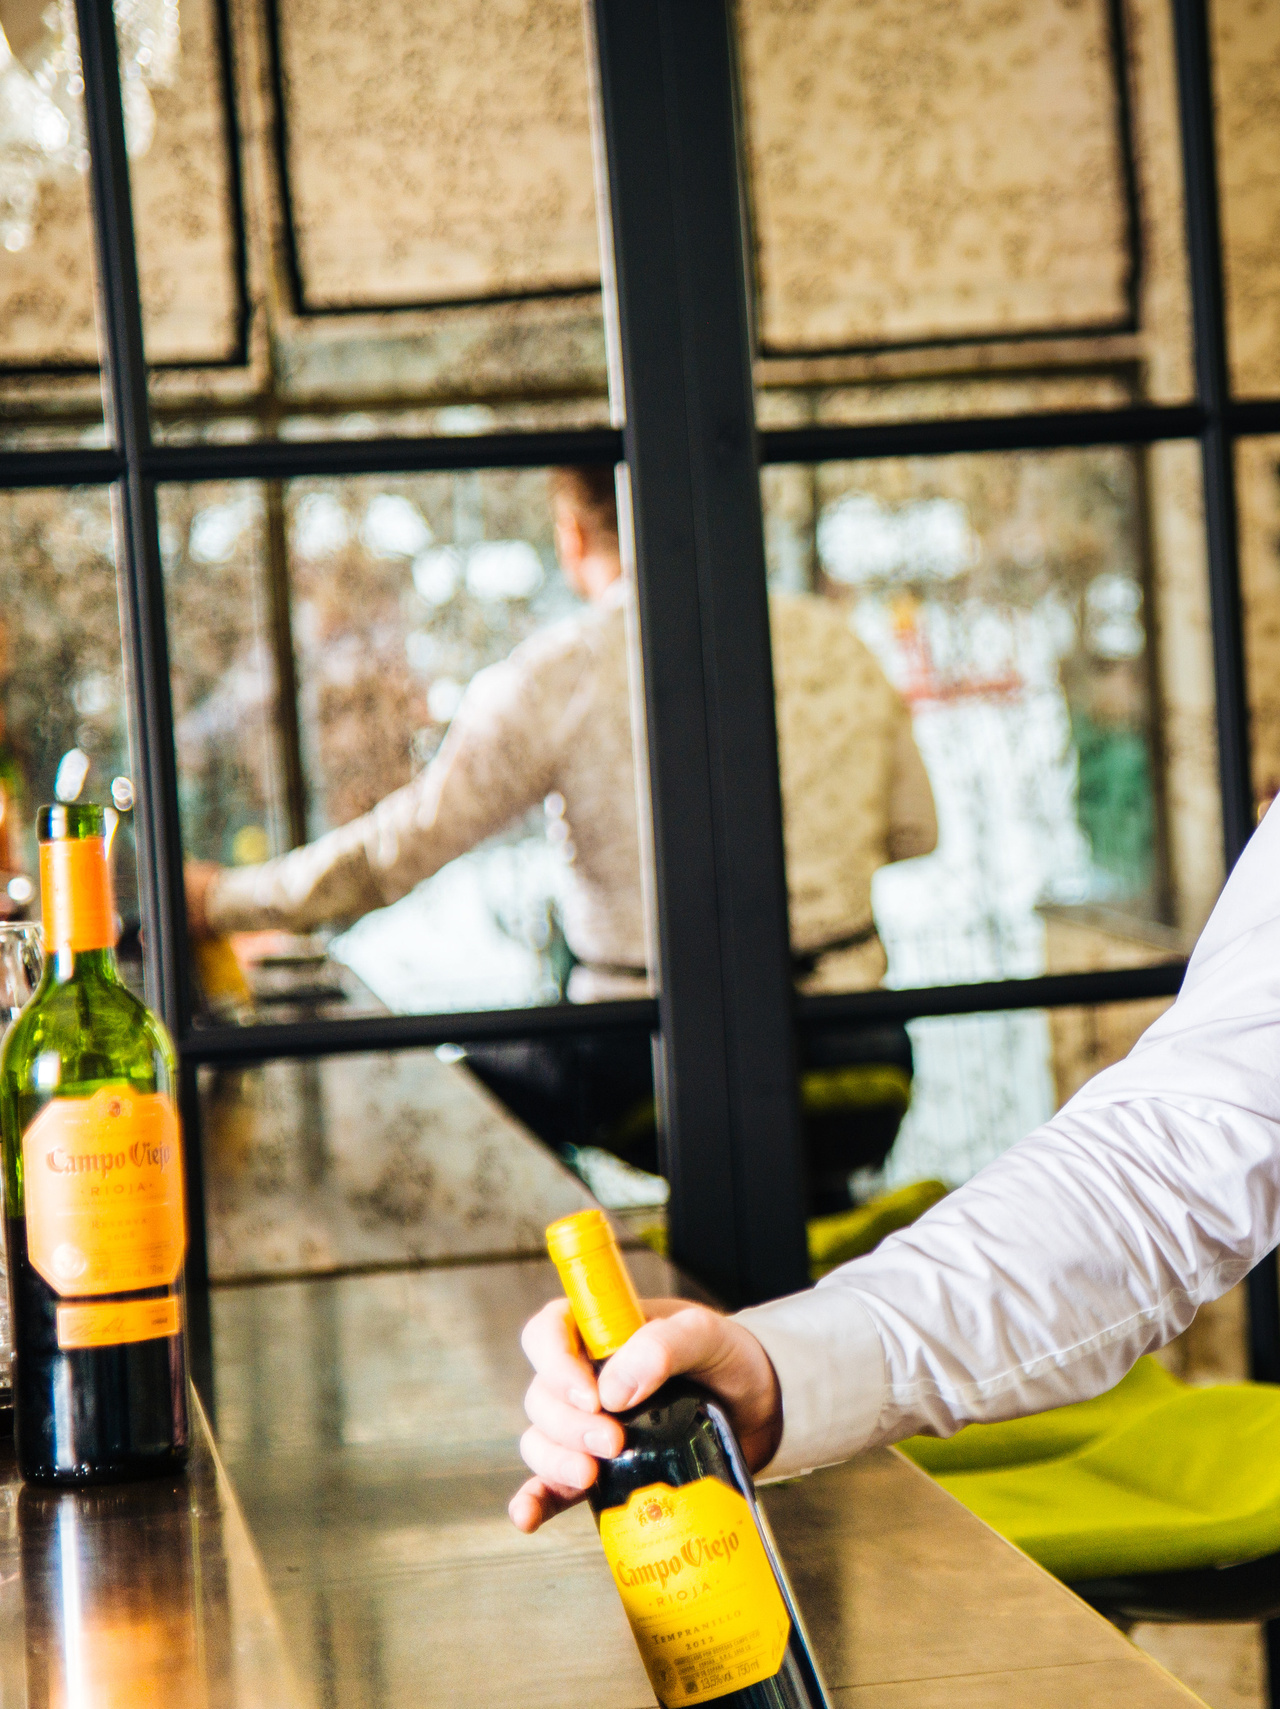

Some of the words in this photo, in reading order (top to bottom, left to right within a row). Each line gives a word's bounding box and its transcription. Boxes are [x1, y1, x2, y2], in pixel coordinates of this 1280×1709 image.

[46, 1146, 126, 1179] Campo
[129, 1140, 170, 1174] Viejo
[90, 1182, 146, 1196] RIOJA
[616, 1555, 682, 1590] Campo
[680, 1530, 739, 1566] Viejo
[656, 1582, 712, 1607] RIOJA
[652, 1610, 741, 1645] TEMPRANILLO
[685, 1636, 714, 1650] 2012
